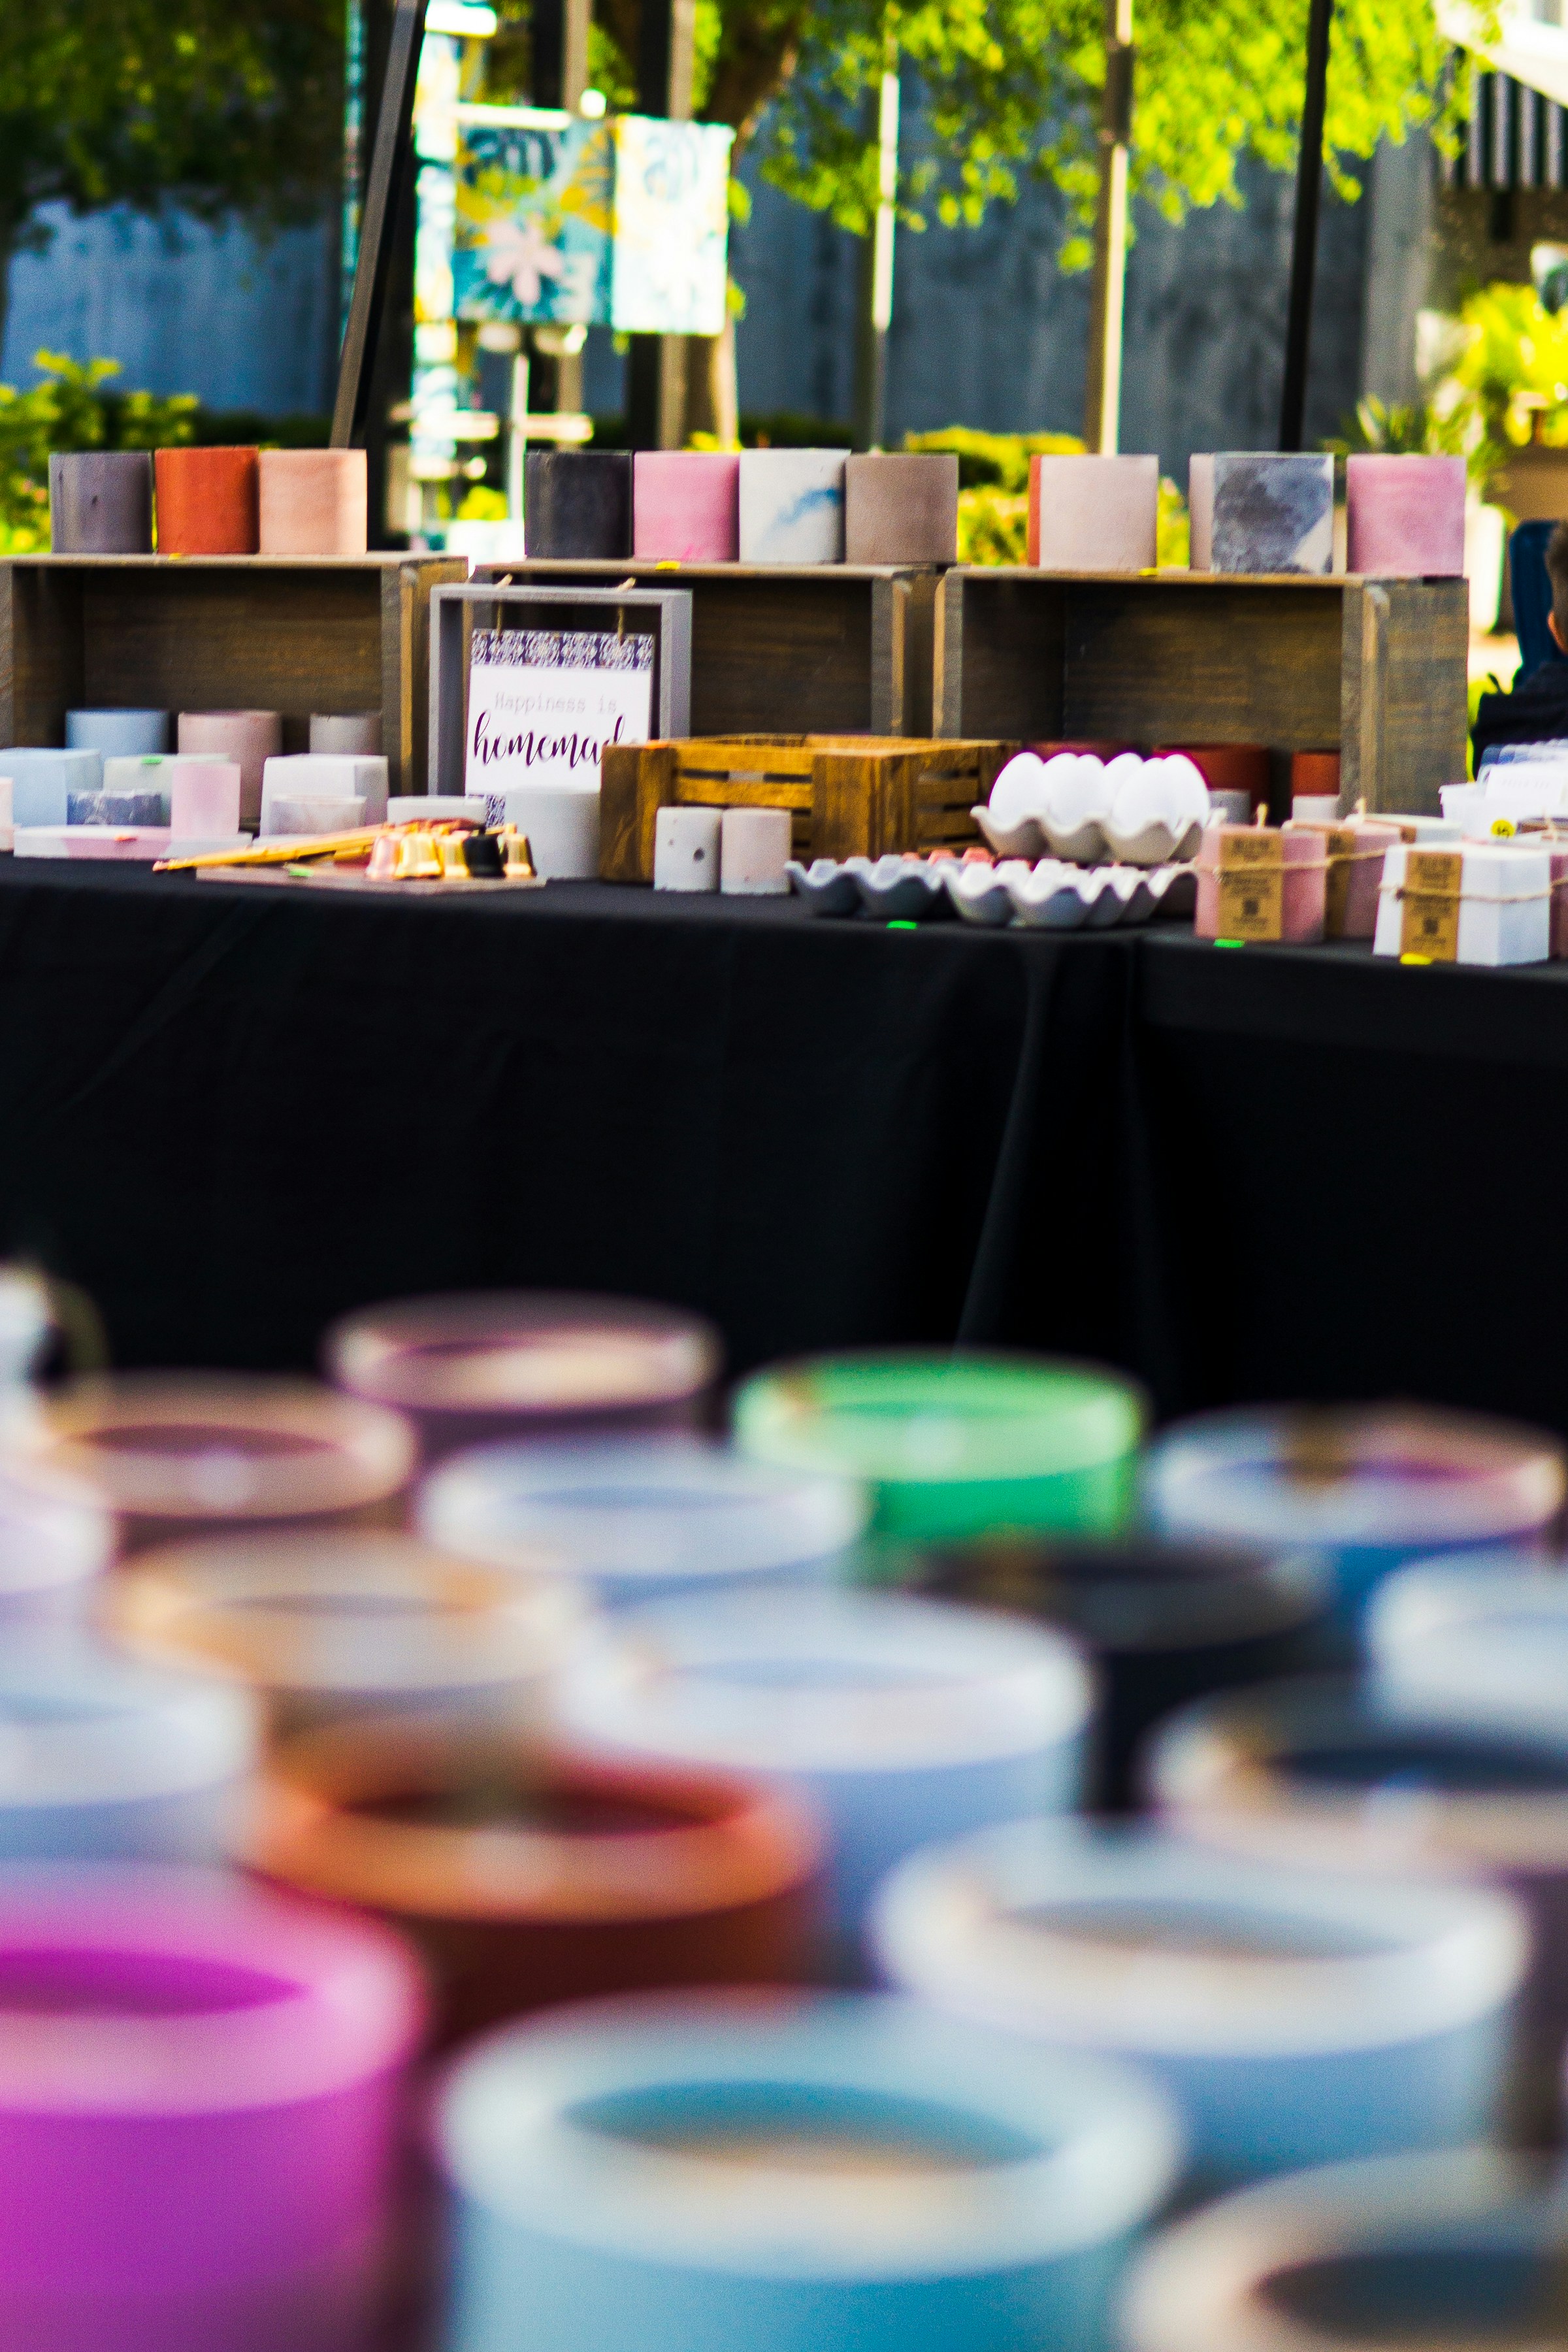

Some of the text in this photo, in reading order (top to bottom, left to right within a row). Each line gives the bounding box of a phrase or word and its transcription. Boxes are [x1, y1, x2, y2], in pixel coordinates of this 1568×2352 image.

[495, 692, 617, 715] Happiness is
[474, 709, 639, 769] homemad
